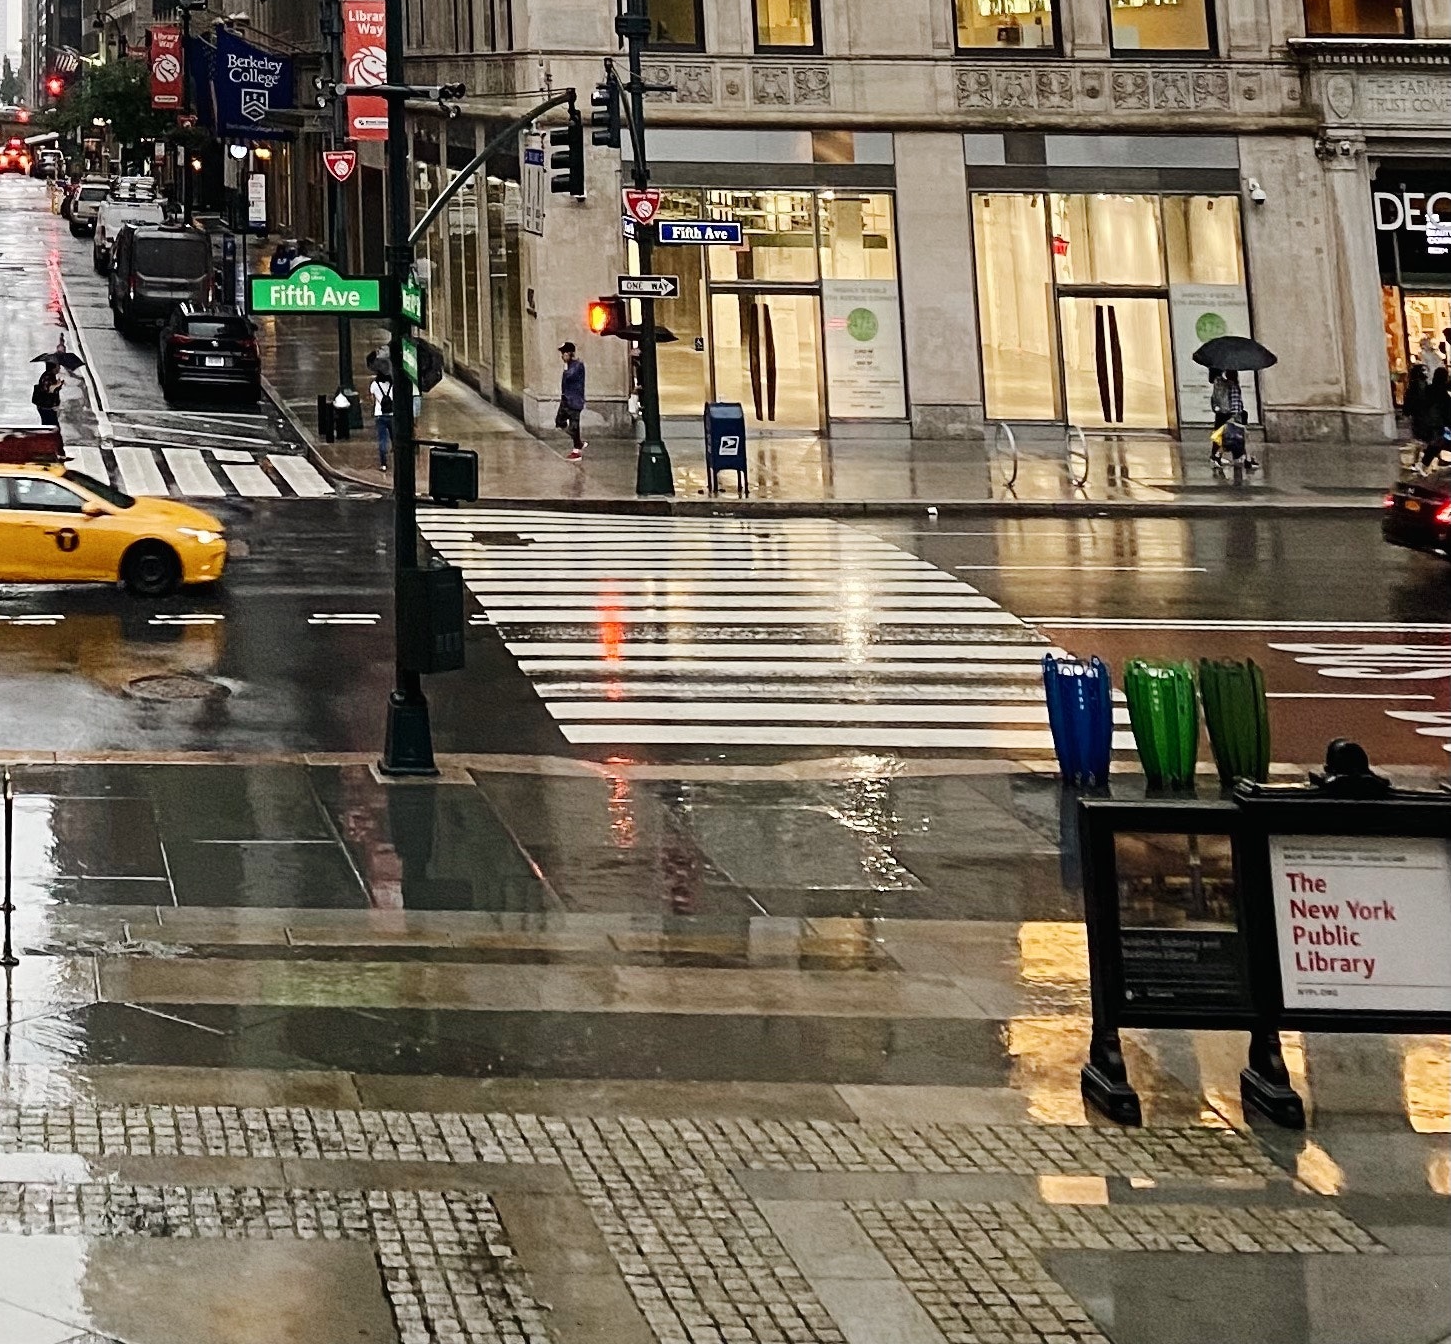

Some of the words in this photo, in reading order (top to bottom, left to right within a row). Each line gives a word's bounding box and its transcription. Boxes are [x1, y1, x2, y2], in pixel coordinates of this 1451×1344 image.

[348, 9, 386, 23] Librar
[357, 23, 384, 38] Way
[227, 53, 283, 74] Berkeley
[229, 67, 280, 88] College
[1368, 97, 1407, 113] TRUST
[671, 226, 702, 240] Fifth
[704, 226, 728, 240] Ave
[270, 284, 316, 306] Fifth
[321, 286, 361, 306] Ave
[626, 281, 644, 291] ONE
[651, 282, 669, 291] WAY
[1286, 871, 1327, 894] The
[1289, 898, 1340, 920] New
[1345, 899, 1397, 921] York
[1293, 924, 1362, 947] Public
[1295, 950, 1376, 980] Library
